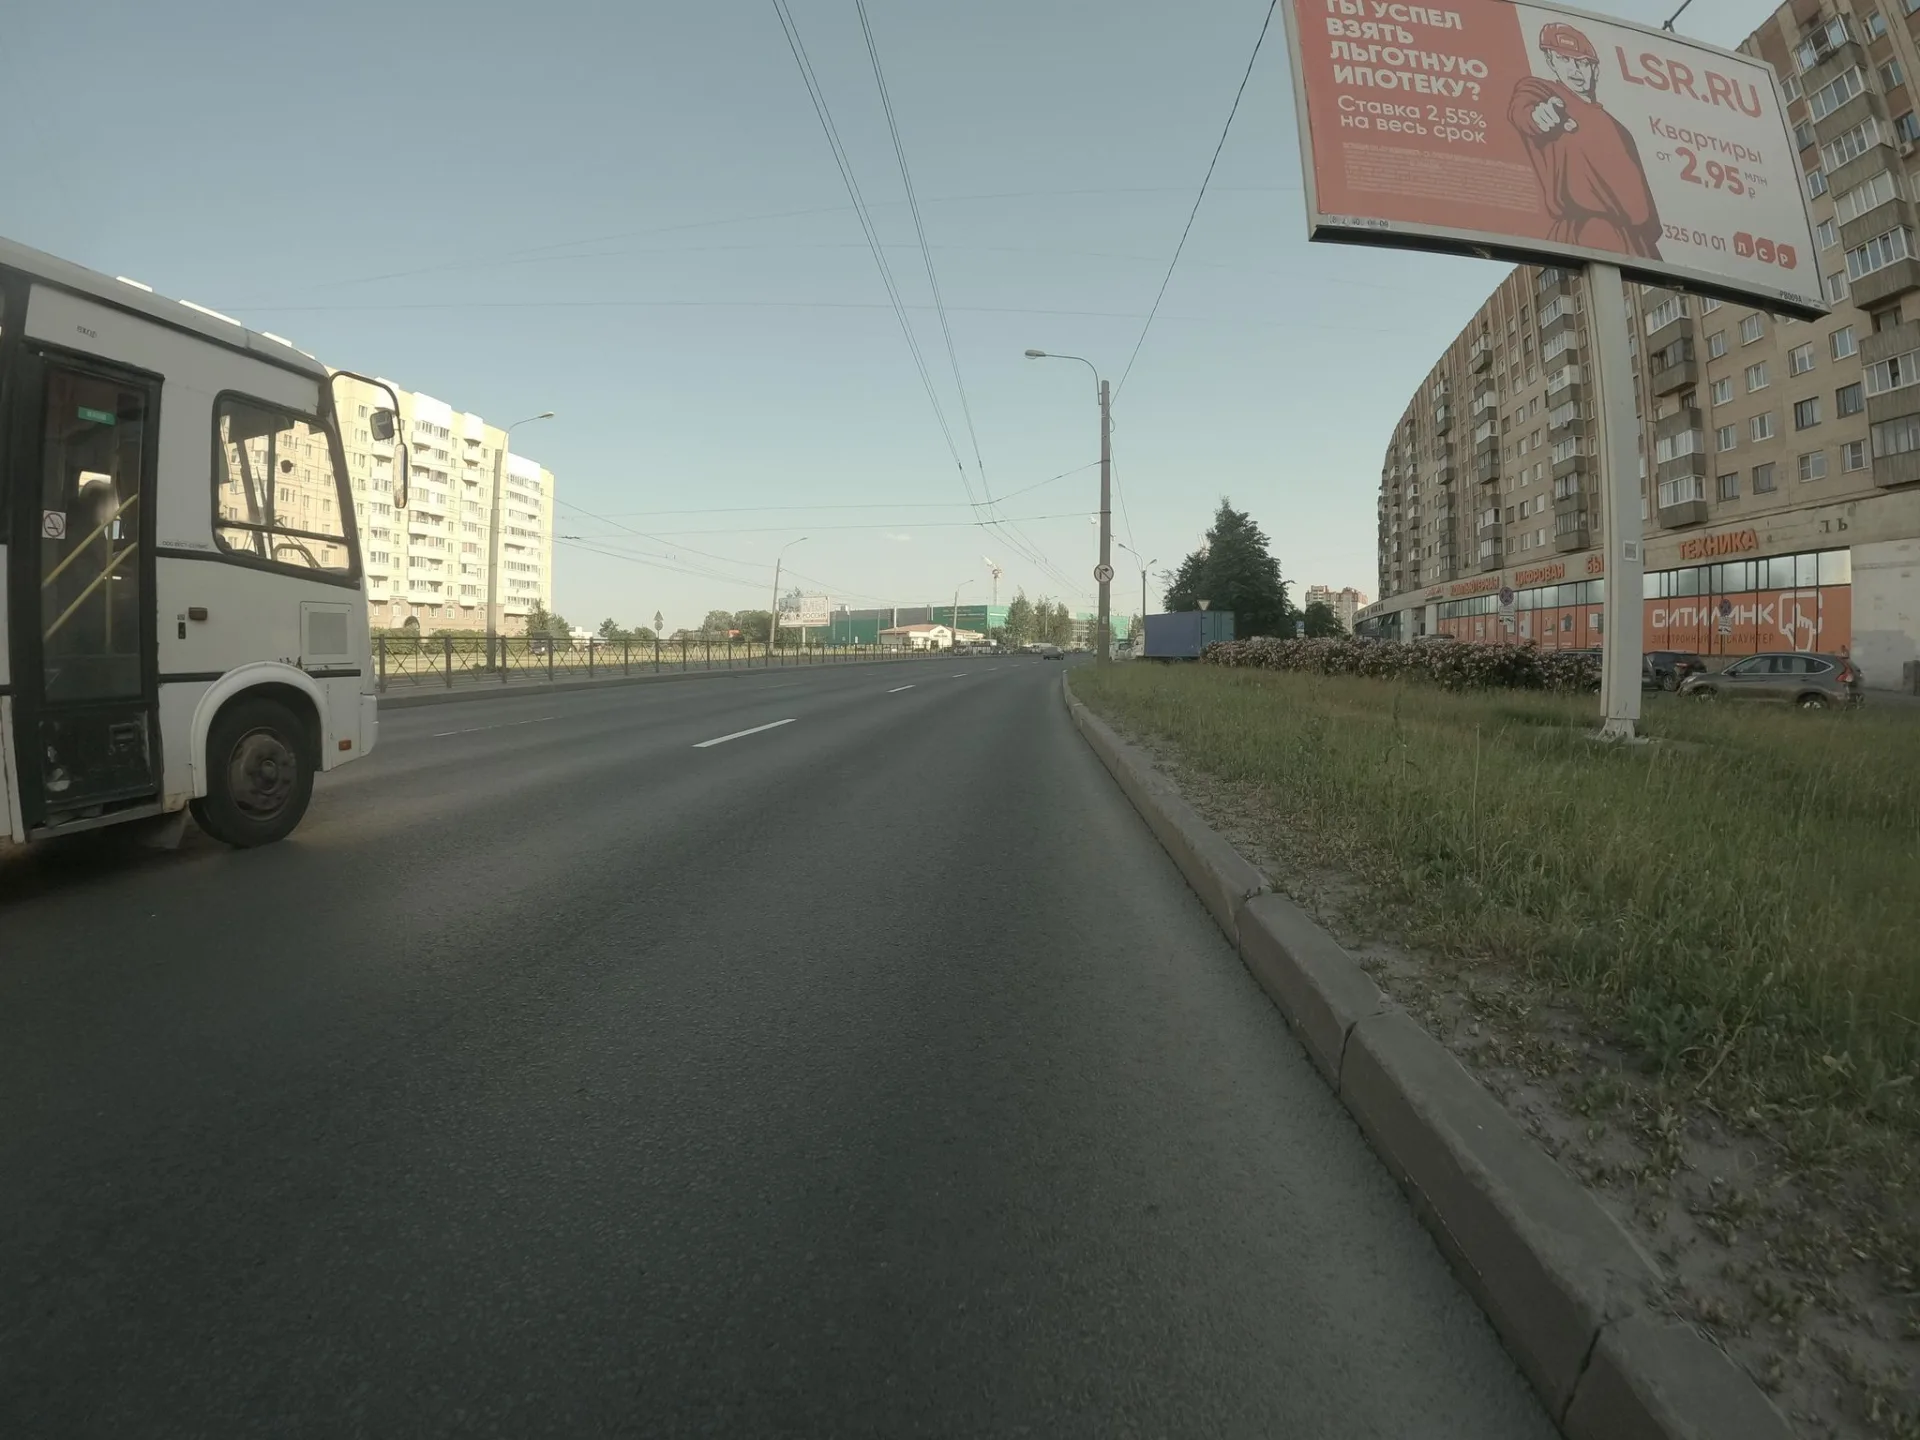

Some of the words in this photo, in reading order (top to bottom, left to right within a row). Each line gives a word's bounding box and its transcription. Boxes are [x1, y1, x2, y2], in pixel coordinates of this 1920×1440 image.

[1326, 0, 1365, 17] ТЫ
[1374, 1, 1463, 30] УСПЕЛ
[1326, 17, 1414, 44] ВЗЯТЬ
[1330, 40, 1489, 78] ЛЬГОТНУЮ
[1333, 64, 1481, 101] ИПОТЕКУ?
[1614, 45, 1762, 118] LSR.RU
[1337, 94, 1421, 120] Ставка
[1426, 104, 1488, 129] 2,55%
[1340, 115, 1370, 129] на
[1376, 117, 1428, 135] весь
[1433, 125, 1487, 144] срок
[1648, 115, 1762, 164] Квартиры
[1656, 150, 1672, 163] от
[1674, 146, 1745, 196] 2,95
[1744, 171, 1768, 186] млн
[1662, 223, 1690, 243] 325
[1692, 228, 1708, 247] 01
[1711, 233, 1727, 252] 01
[1515, 563, 1566, 588] ЦИФРОВАЯ
[1679, 528, 1759, 560] ТЕХНИКА
